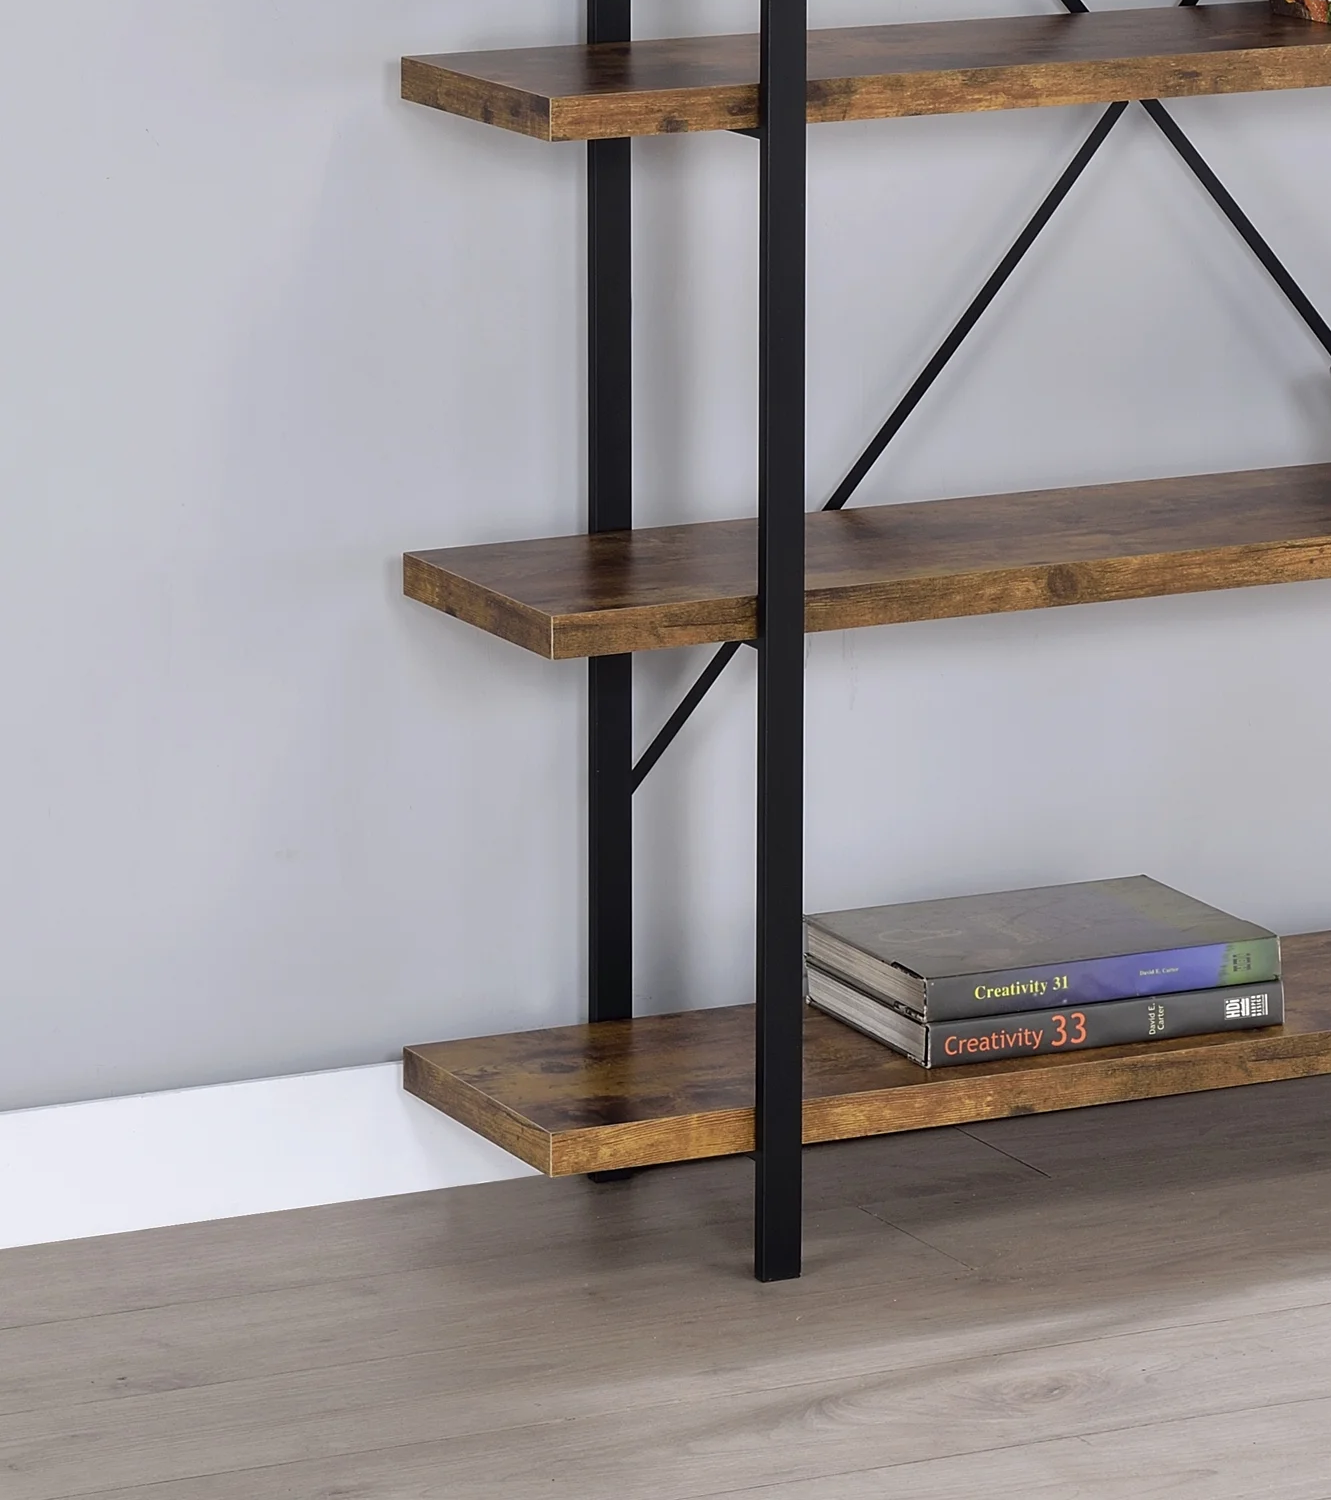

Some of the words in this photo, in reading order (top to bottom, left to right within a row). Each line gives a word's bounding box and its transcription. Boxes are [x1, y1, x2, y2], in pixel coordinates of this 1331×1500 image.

[975, 980, 1048, 999] Creativity
[1053, 976, 1068, 990] 31
[1149, 1002, 1156, 1011] E.
[1226, 999, 1240, 1018] HDi
[945, 1028, 1043, 1056] Creativity
[1051, 1012, 1087, 1047] 33
[1148, 1012, 1156, 1035] David
